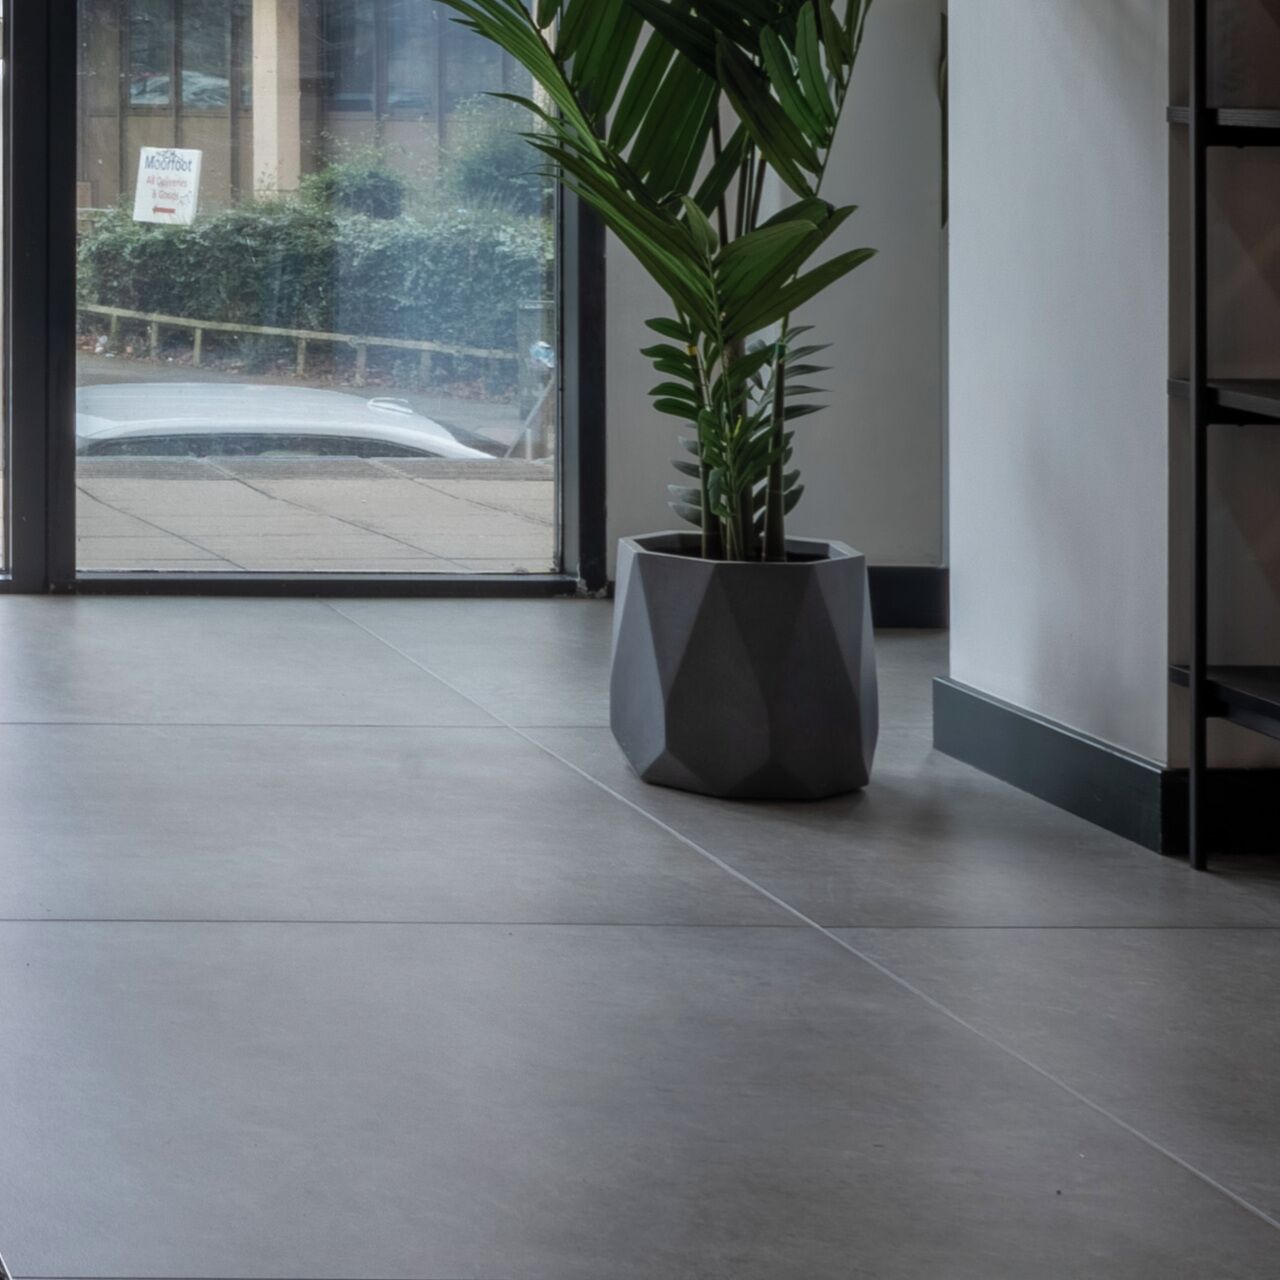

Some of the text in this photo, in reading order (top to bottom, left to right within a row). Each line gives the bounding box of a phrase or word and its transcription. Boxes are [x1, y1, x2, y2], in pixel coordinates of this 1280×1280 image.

[144, 154, 192, 172] Moorfoot
[146, 176, 188, 188] All Deliveries
